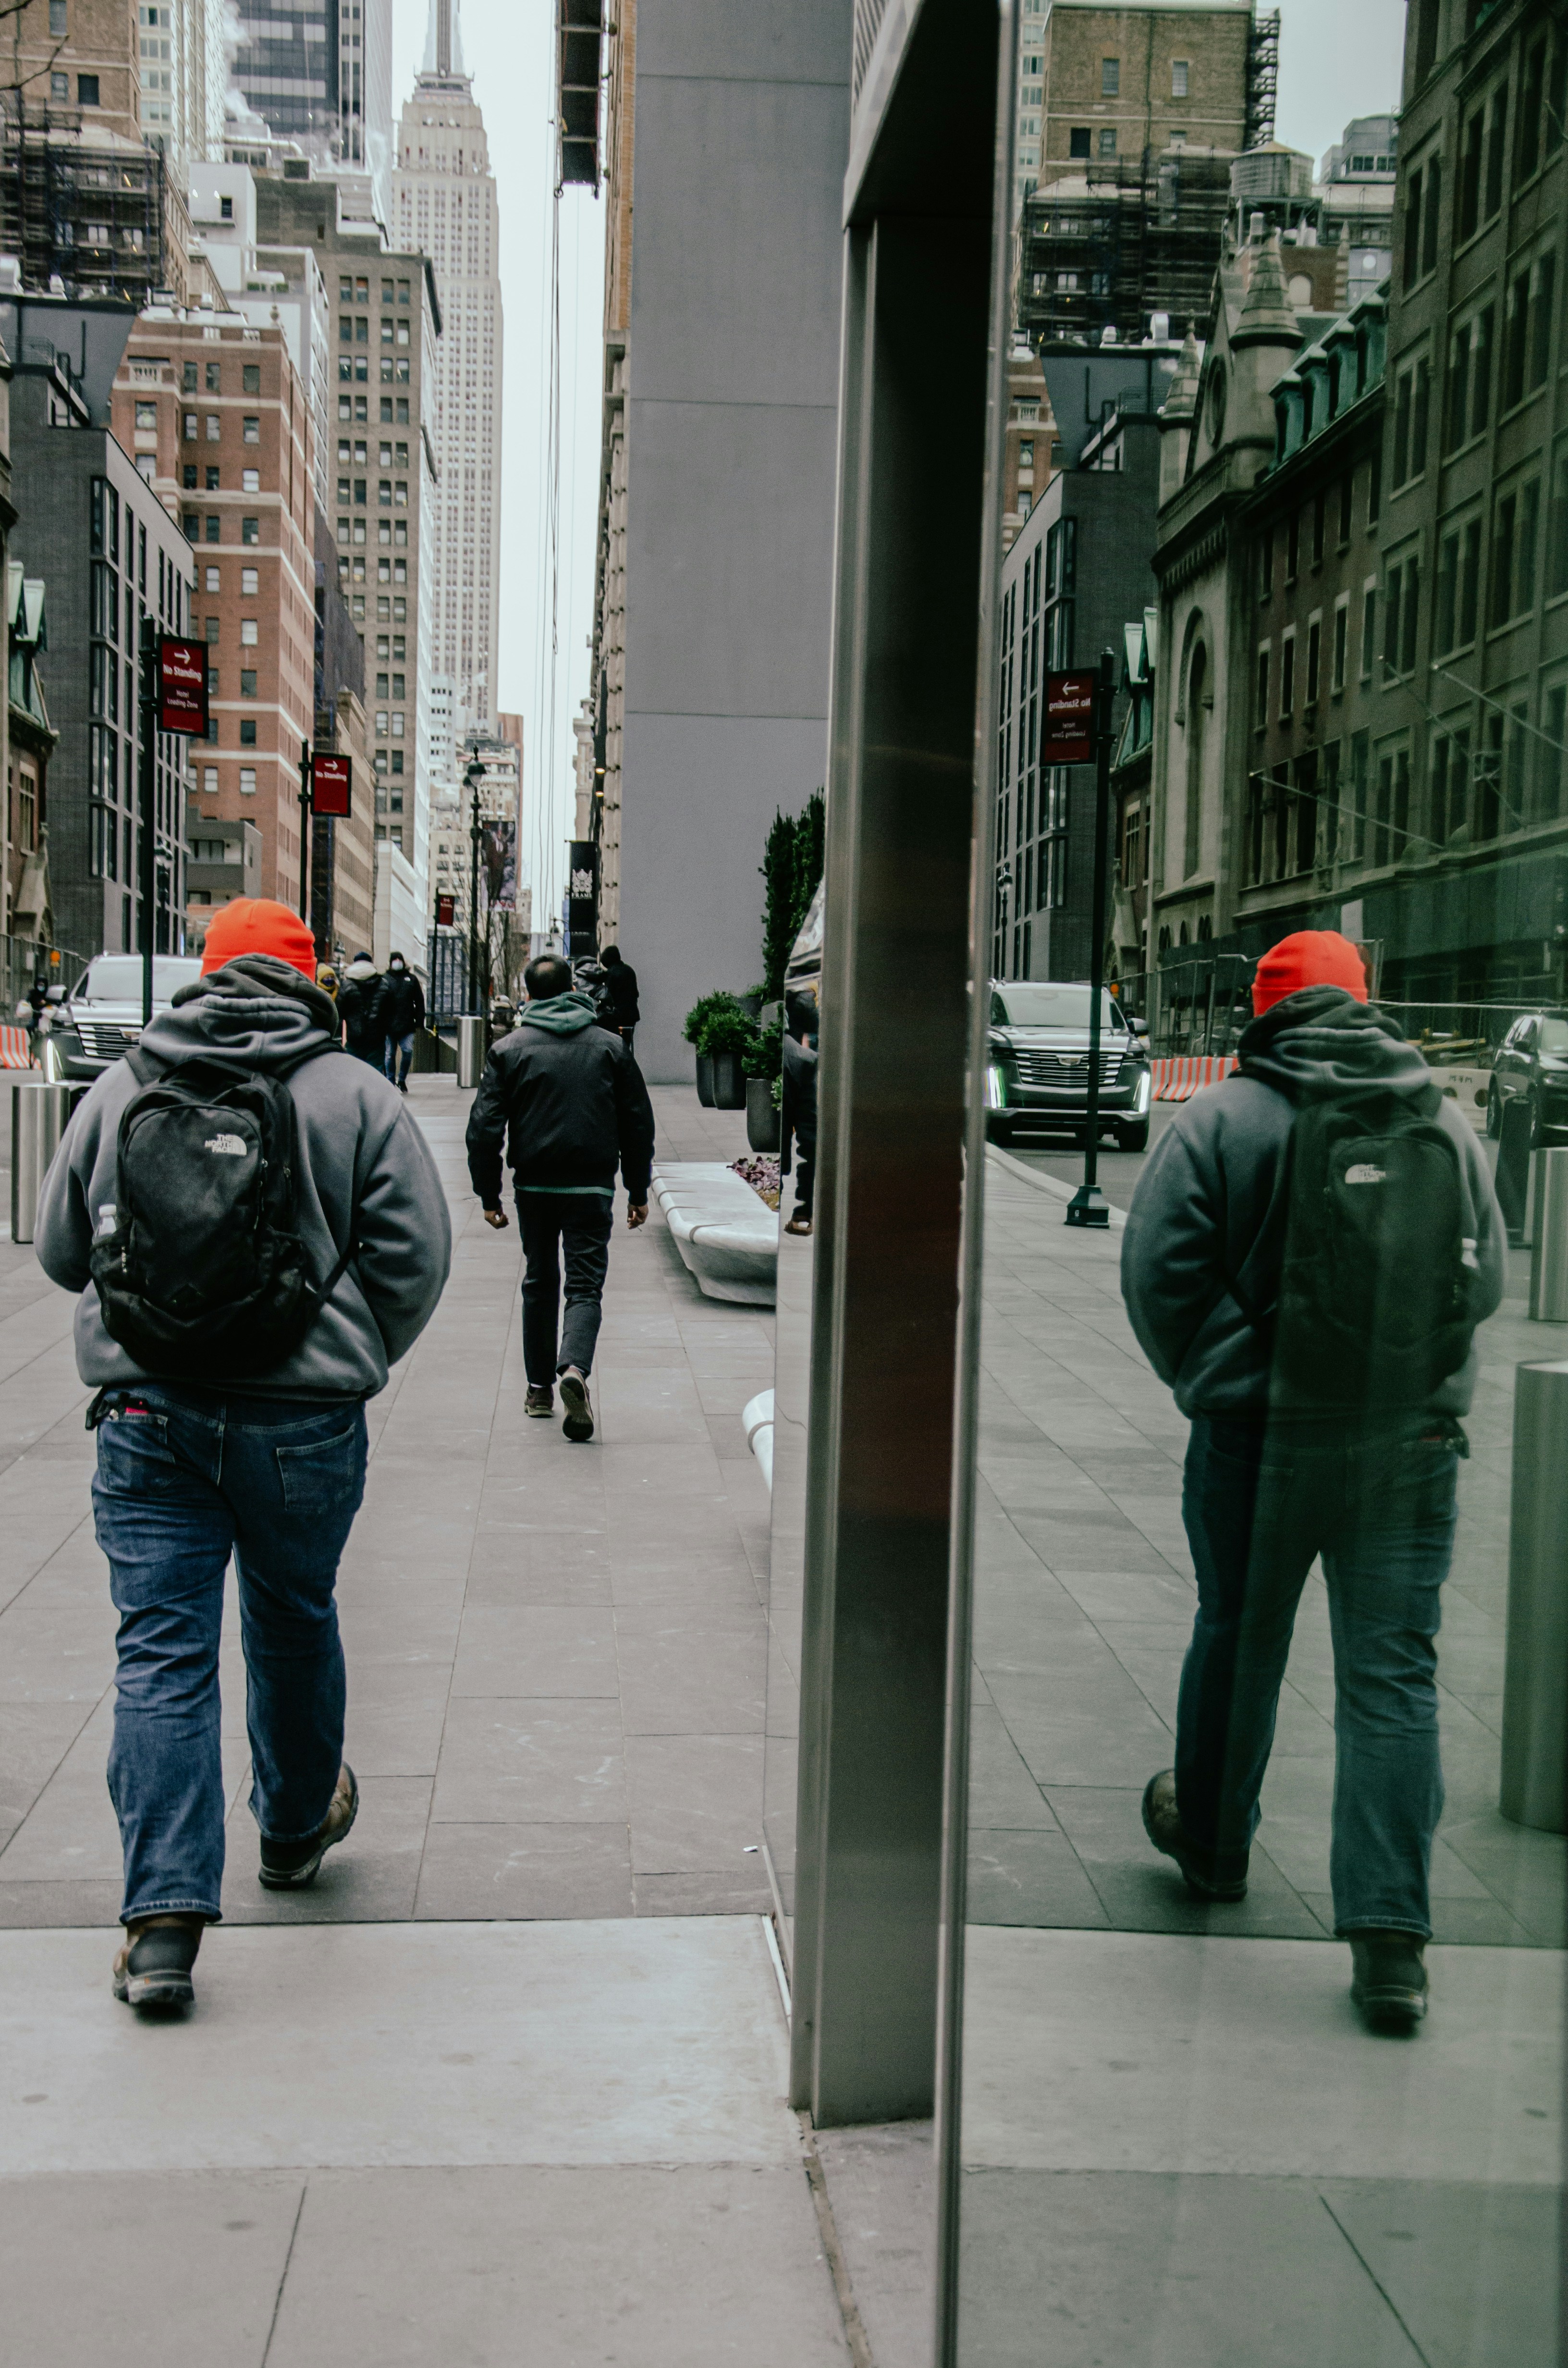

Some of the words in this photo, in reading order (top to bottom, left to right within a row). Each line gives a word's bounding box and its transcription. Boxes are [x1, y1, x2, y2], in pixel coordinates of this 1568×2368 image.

[163, 664, 173, 675] No
[173, 666, 202, 682] Standing
[324, 771, 347, 782] Standing
